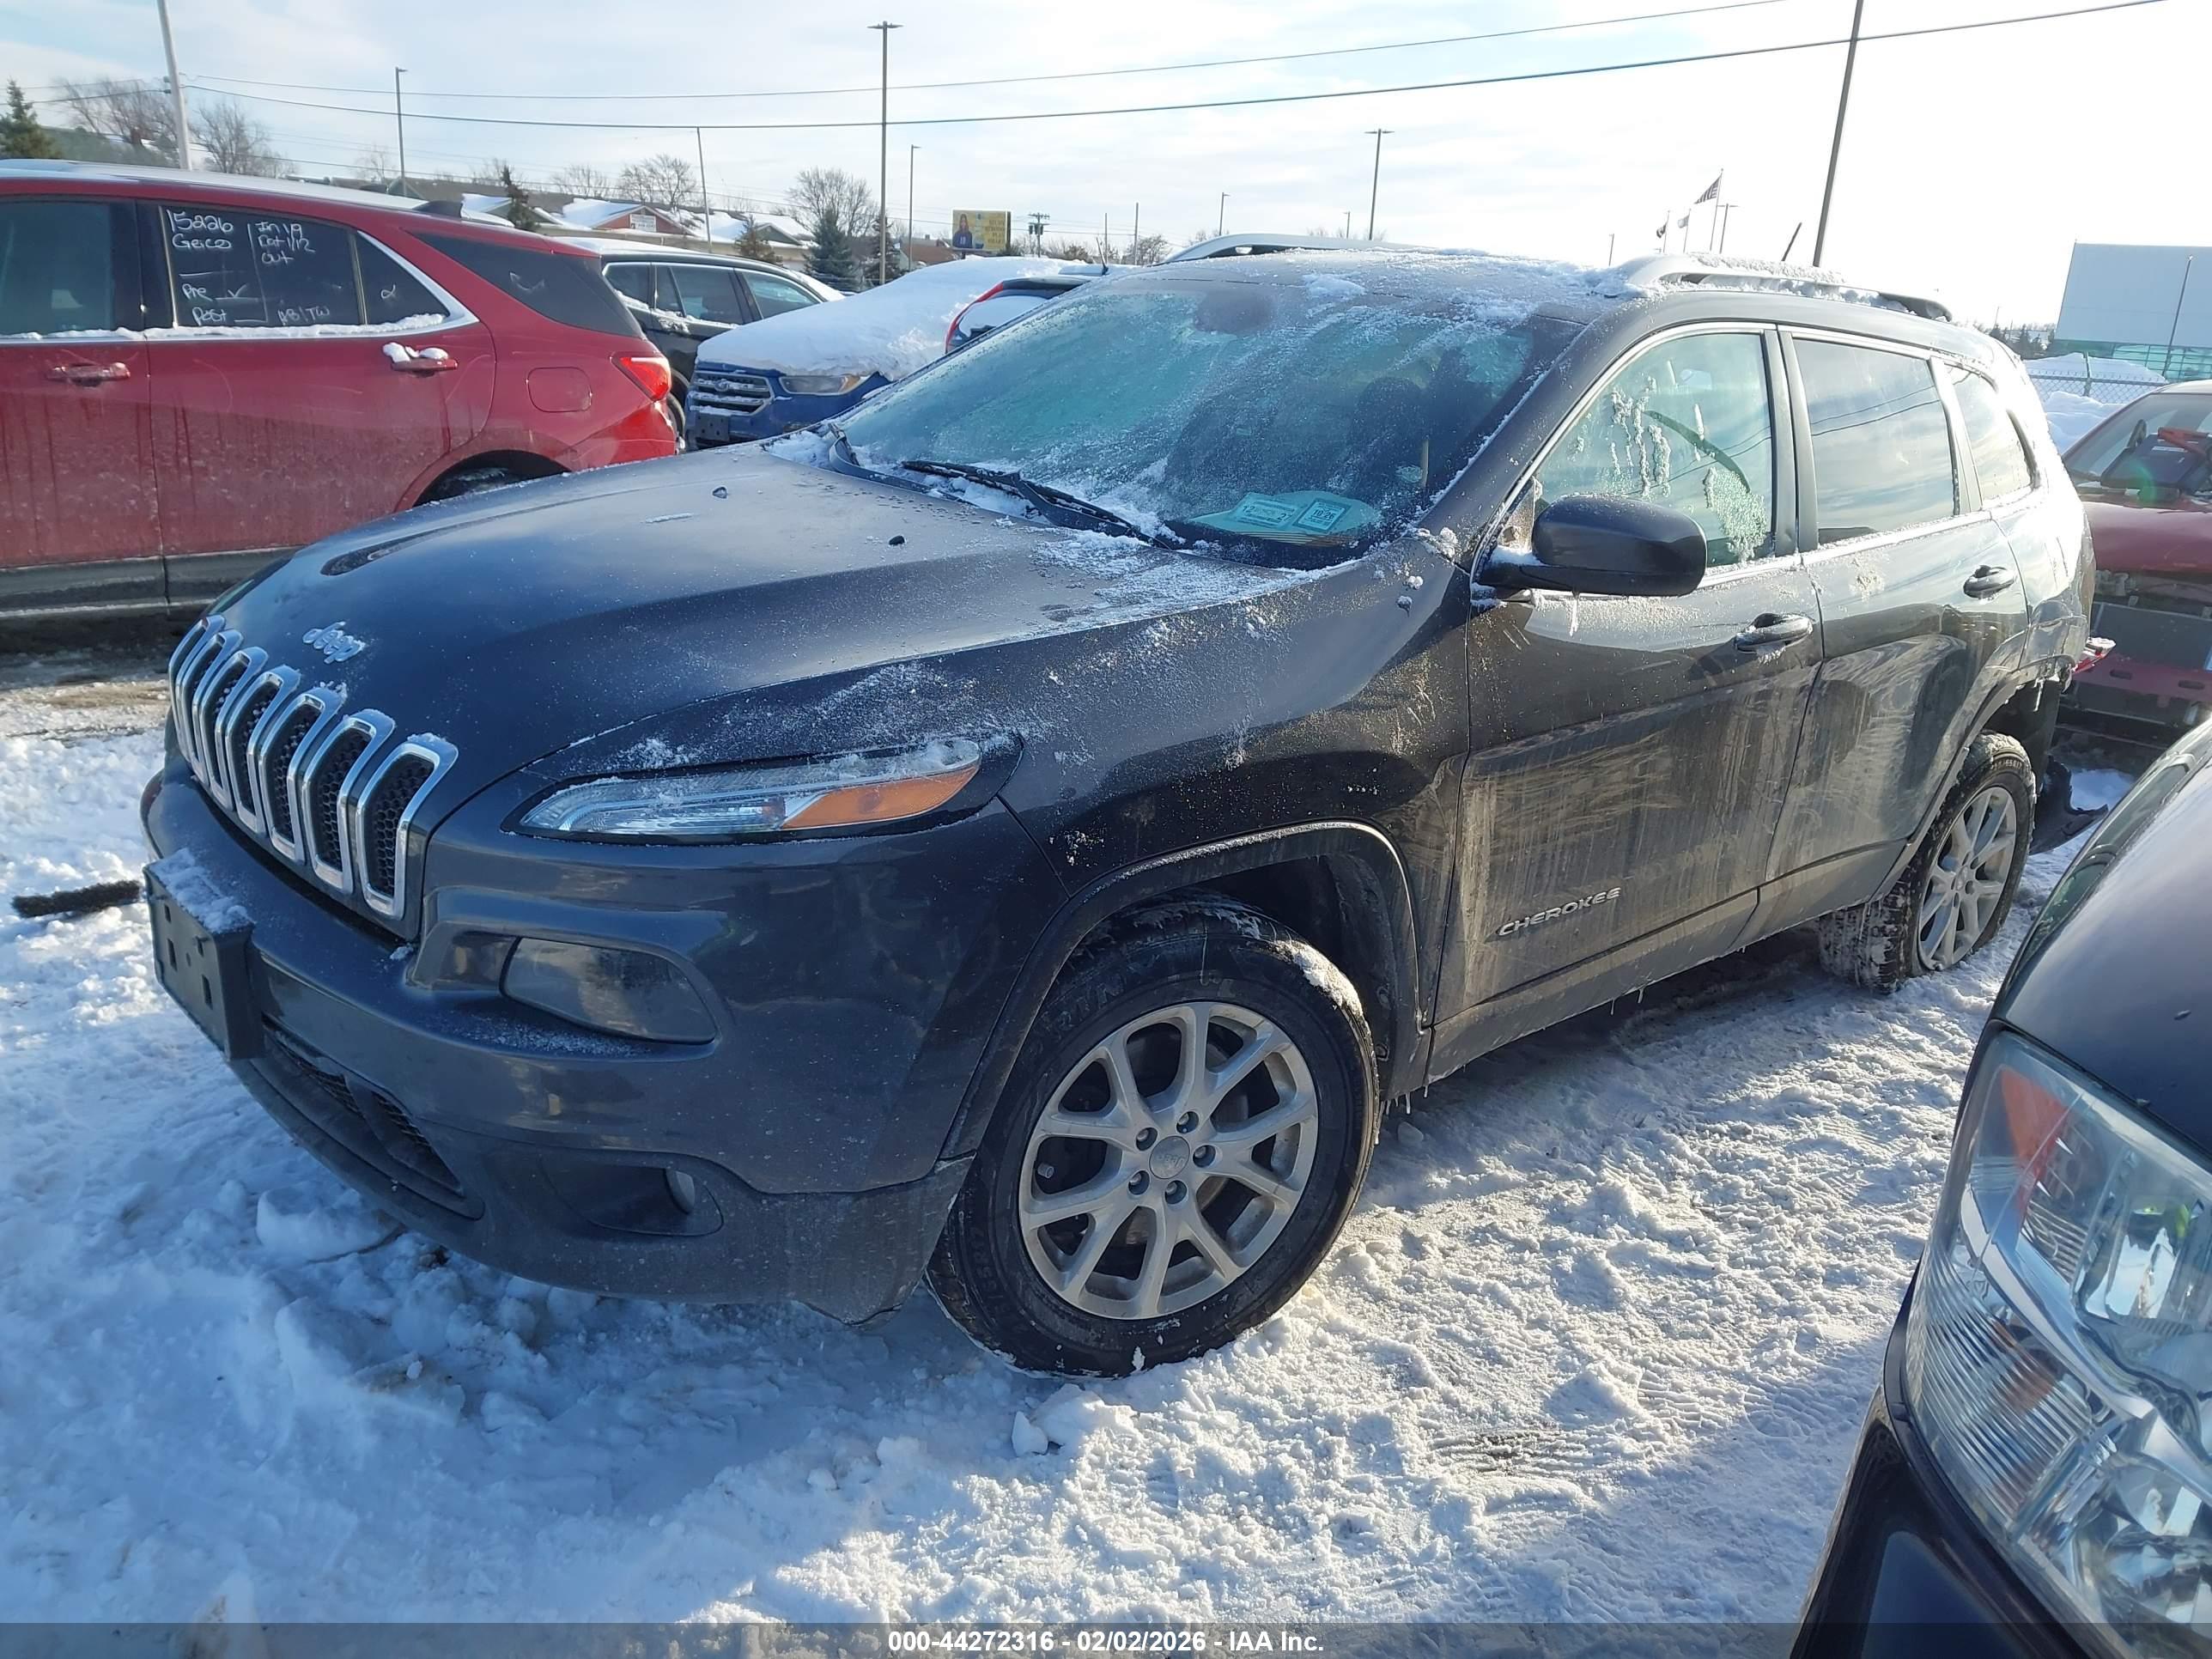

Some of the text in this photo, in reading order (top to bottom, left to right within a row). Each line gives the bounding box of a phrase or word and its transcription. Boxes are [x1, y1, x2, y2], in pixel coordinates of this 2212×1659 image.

[166, 210, 234, 233] 15226
[172, 233, 232, 249] Geico
[182, 283, 213, 301] Pre
[192, 307, 227, 325] Post
[302, 621, 362, 664] Jeep
[1498, 887, 1621, 936] CHEROKEE
